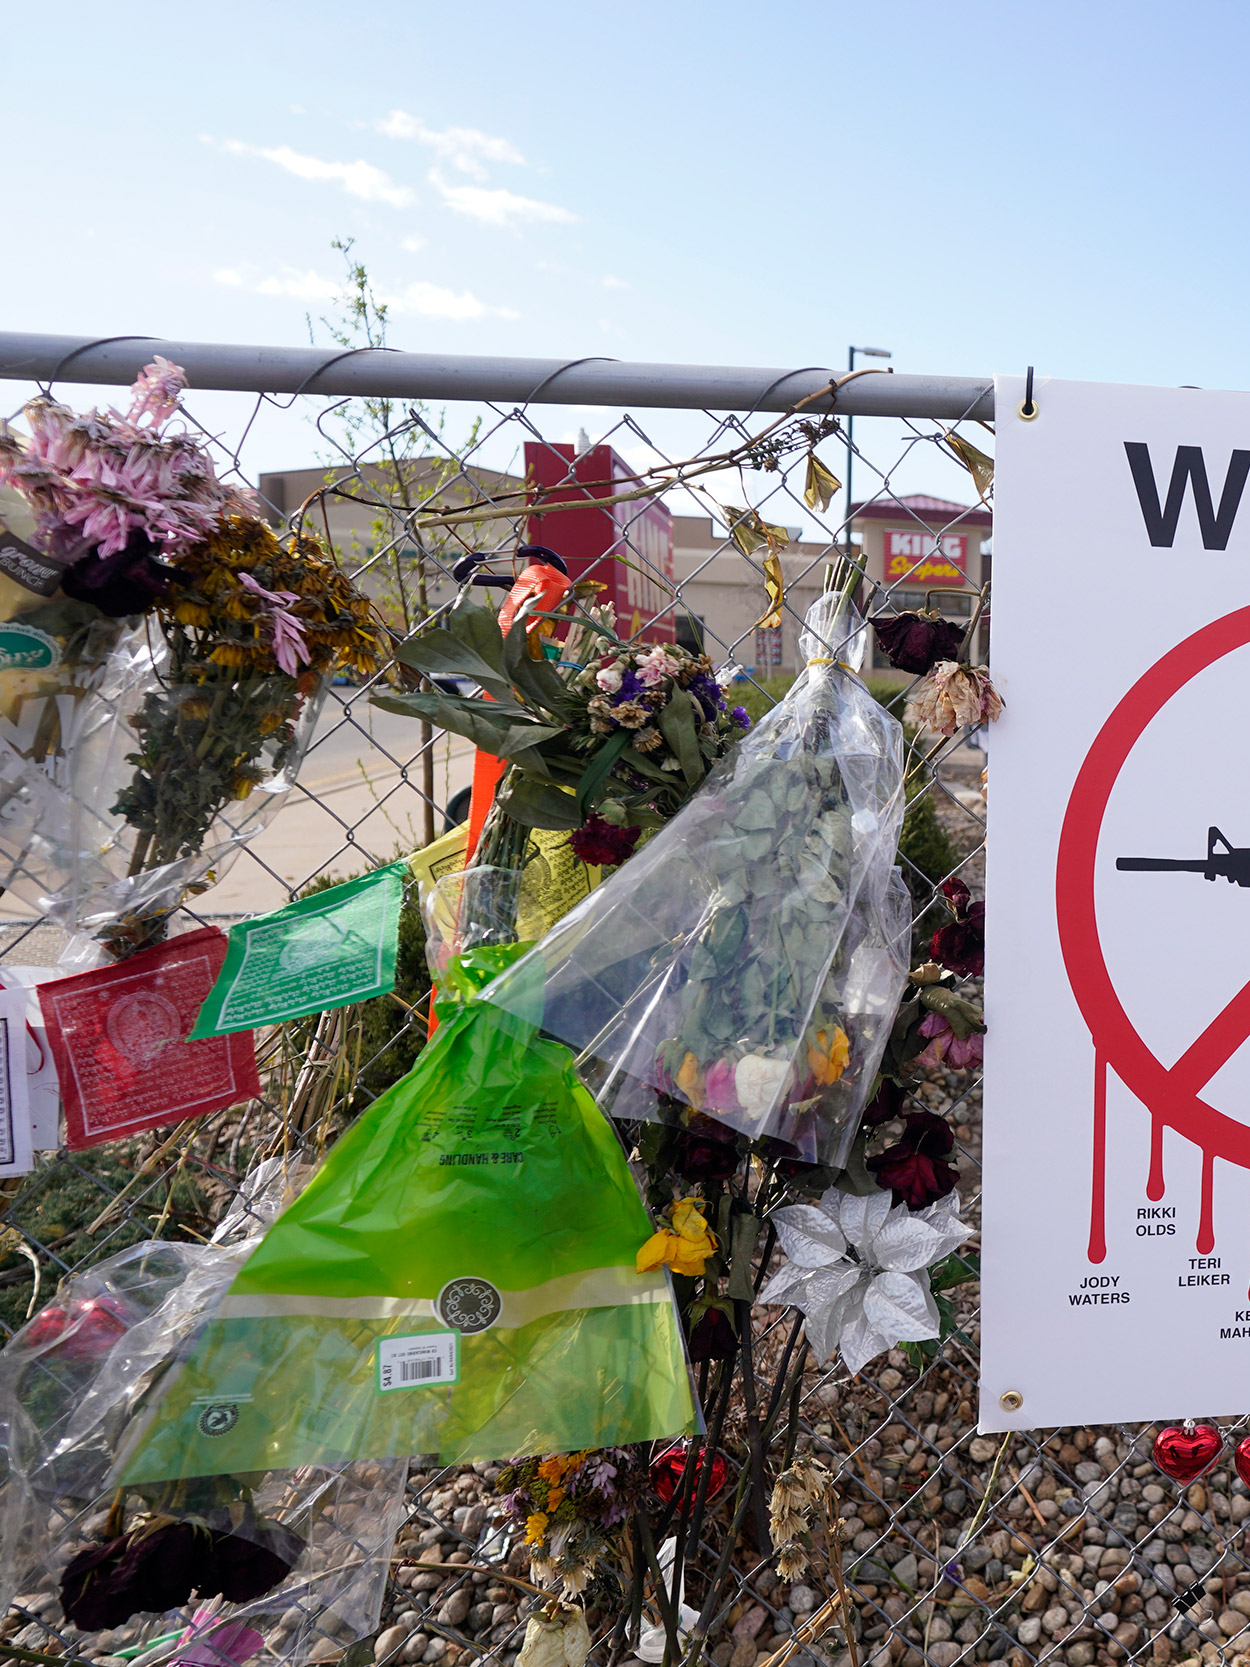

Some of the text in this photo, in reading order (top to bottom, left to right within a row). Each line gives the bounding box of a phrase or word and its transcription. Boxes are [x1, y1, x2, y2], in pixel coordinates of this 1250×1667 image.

[891, 533, 961, 559] KING
[1, 558, 45, 588] BUNCH
[439, 1152, 524, 1165] CARE & HANDLING
[1137, 1207, 1176, 1220] RIKKI
[1135, 1223, 1176, 1237] OLDS
[1188, 1257, 1221, 1270] TERI
[1079, 1275, 1120, 1289] JODY
[1178, 1273, 1231, 1287] LEIKER
[1068, 1292, 1130, 1306] WATERS
[383, 1365, 392, 1387] $4.87
